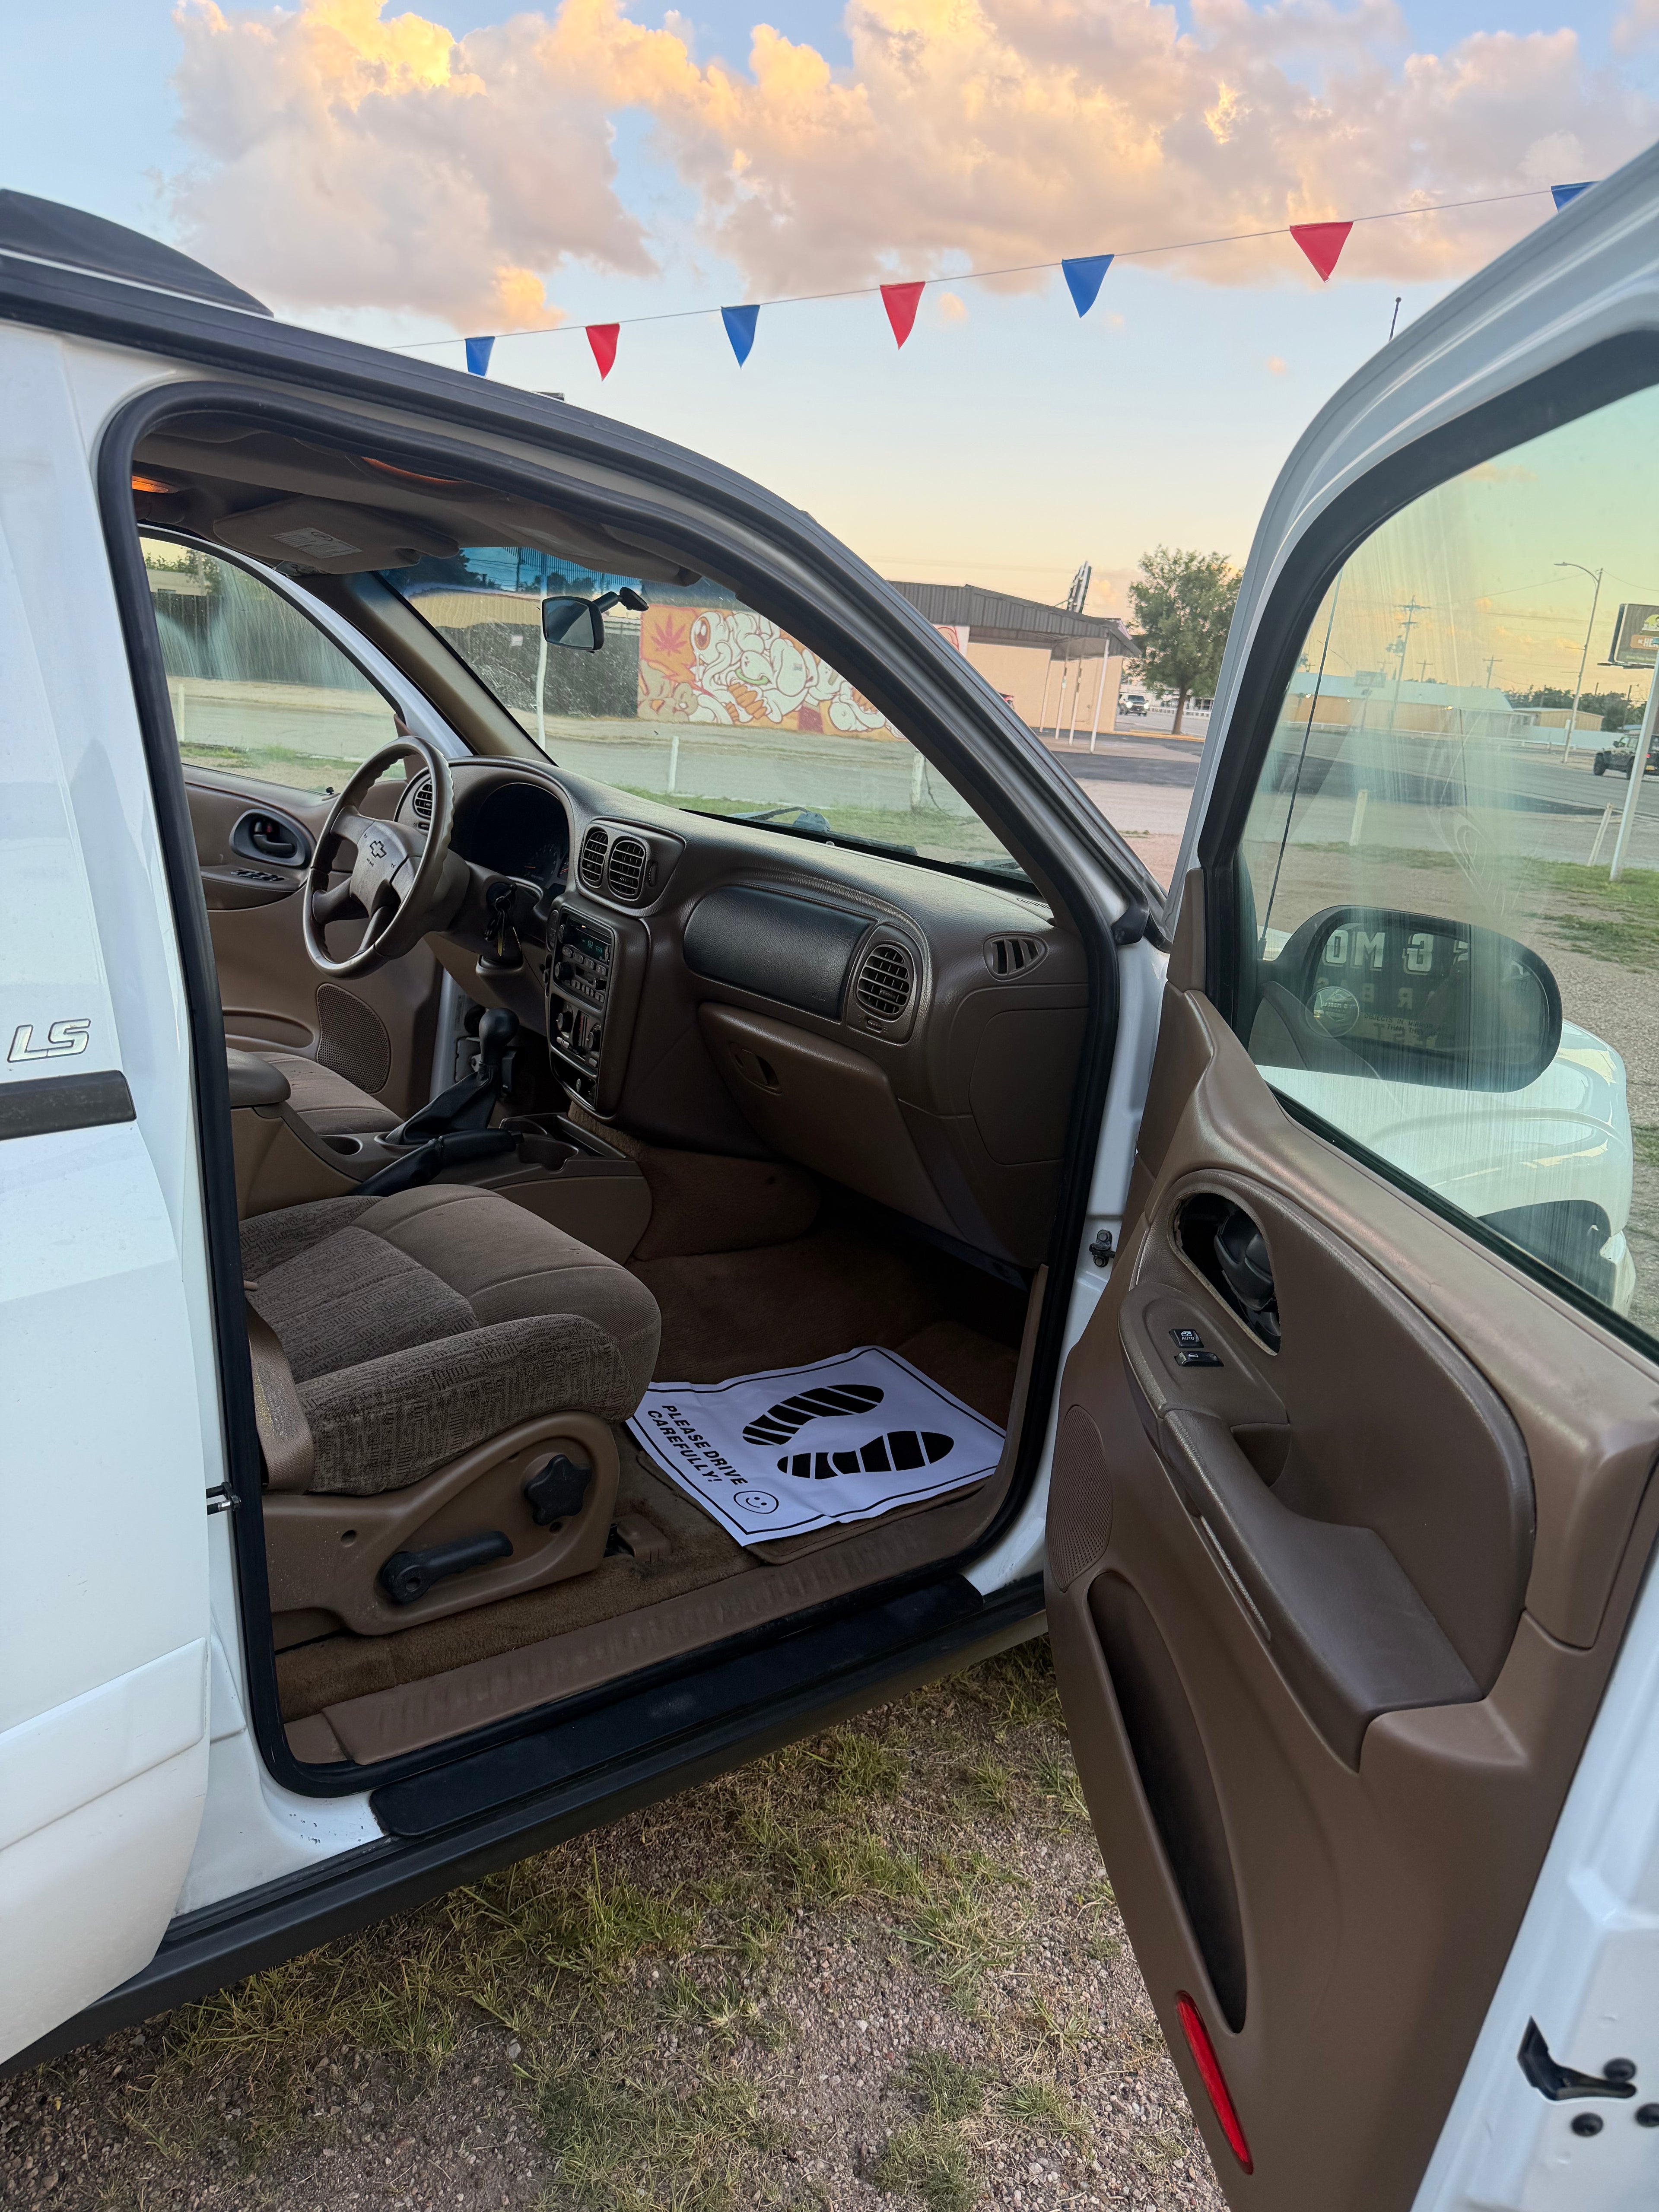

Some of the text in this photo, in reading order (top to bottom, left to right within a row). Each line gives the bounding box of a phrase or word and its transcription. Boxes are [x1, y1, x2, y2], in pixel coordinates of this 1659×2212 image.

[7, 1018, 91, 1063] LS
[1364, 1013, 1392, 1023] OBJECTS
[1408, 1020, 1433, 1029] MIRROR
[648, 1410, 723, 1482] CAREFULLY!
[661, 1405, 749, 1485] PLEASE DRIVE
